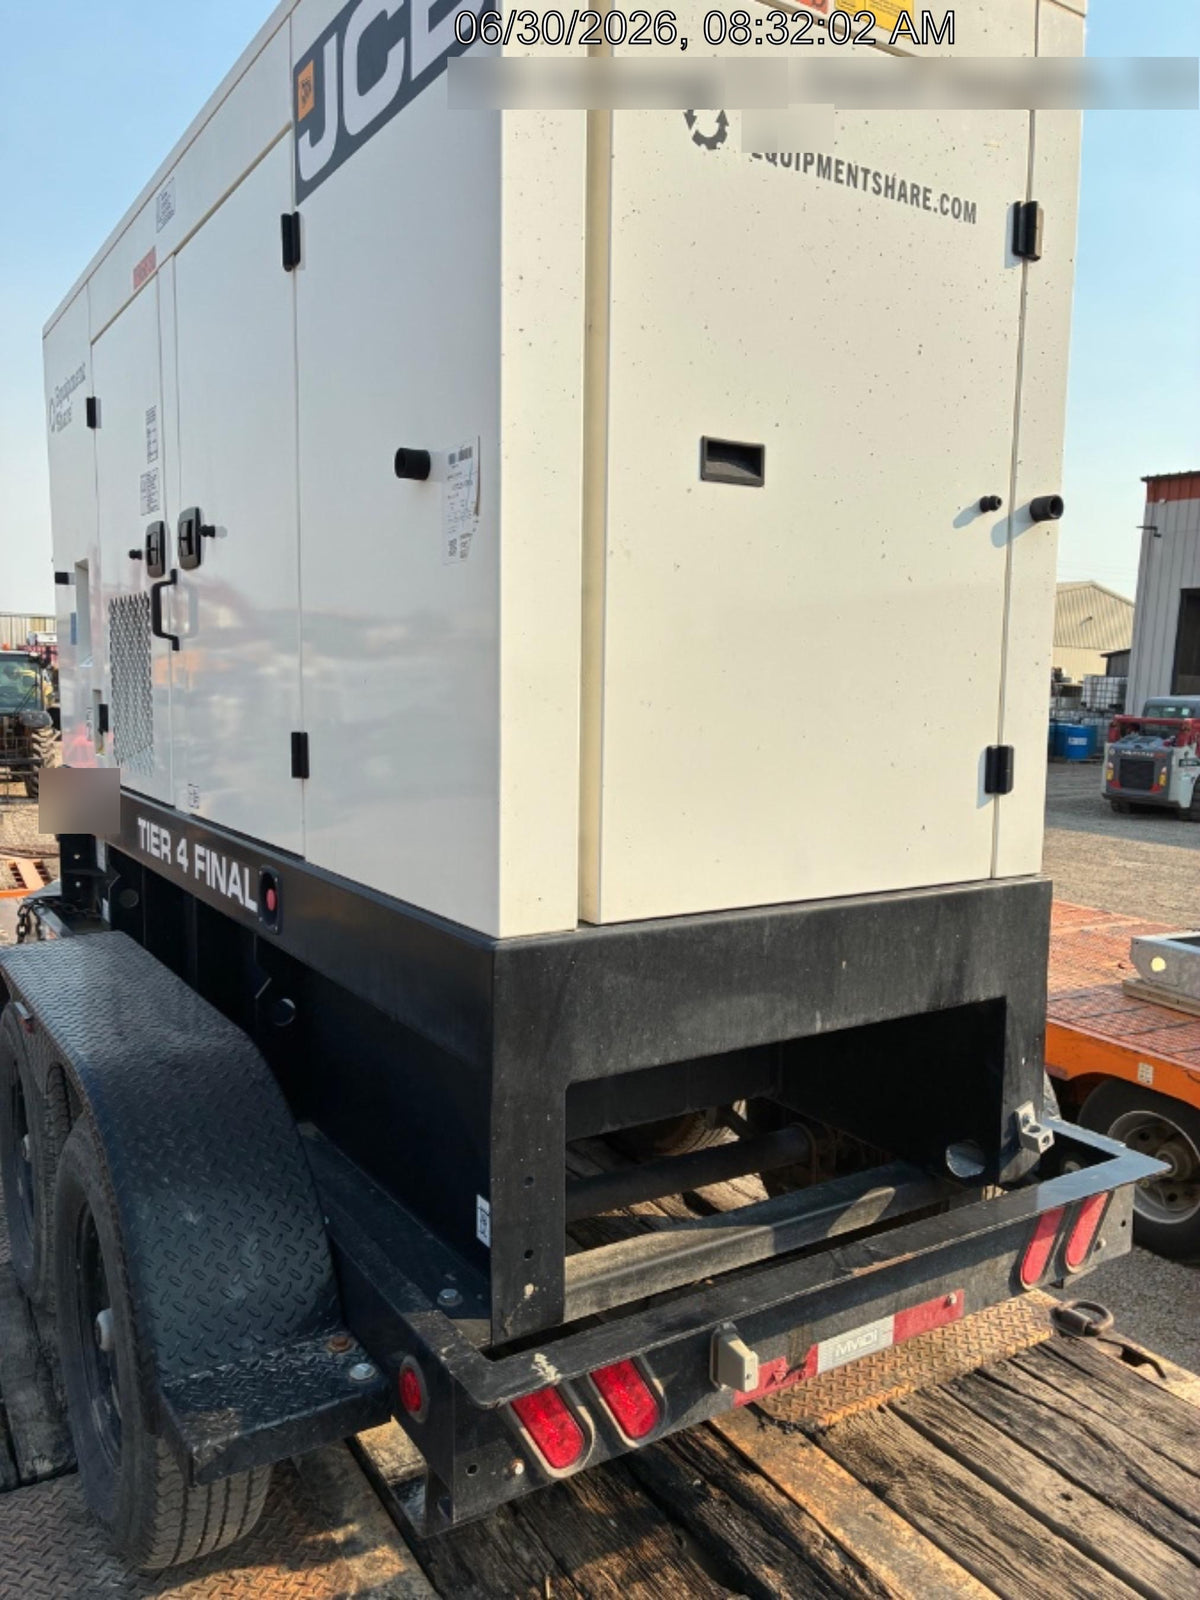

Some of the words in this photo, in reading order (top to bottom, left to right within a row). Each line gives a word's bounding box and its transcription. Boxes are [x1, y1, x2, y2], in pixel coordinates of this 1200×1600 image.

[751, 152, 977, 225] UIPMENTSHARE.COM
[137, 816, 172, 865] TIER
[176, 837, 189, 874] 4
[194, 843, 259, 913] FINAL
